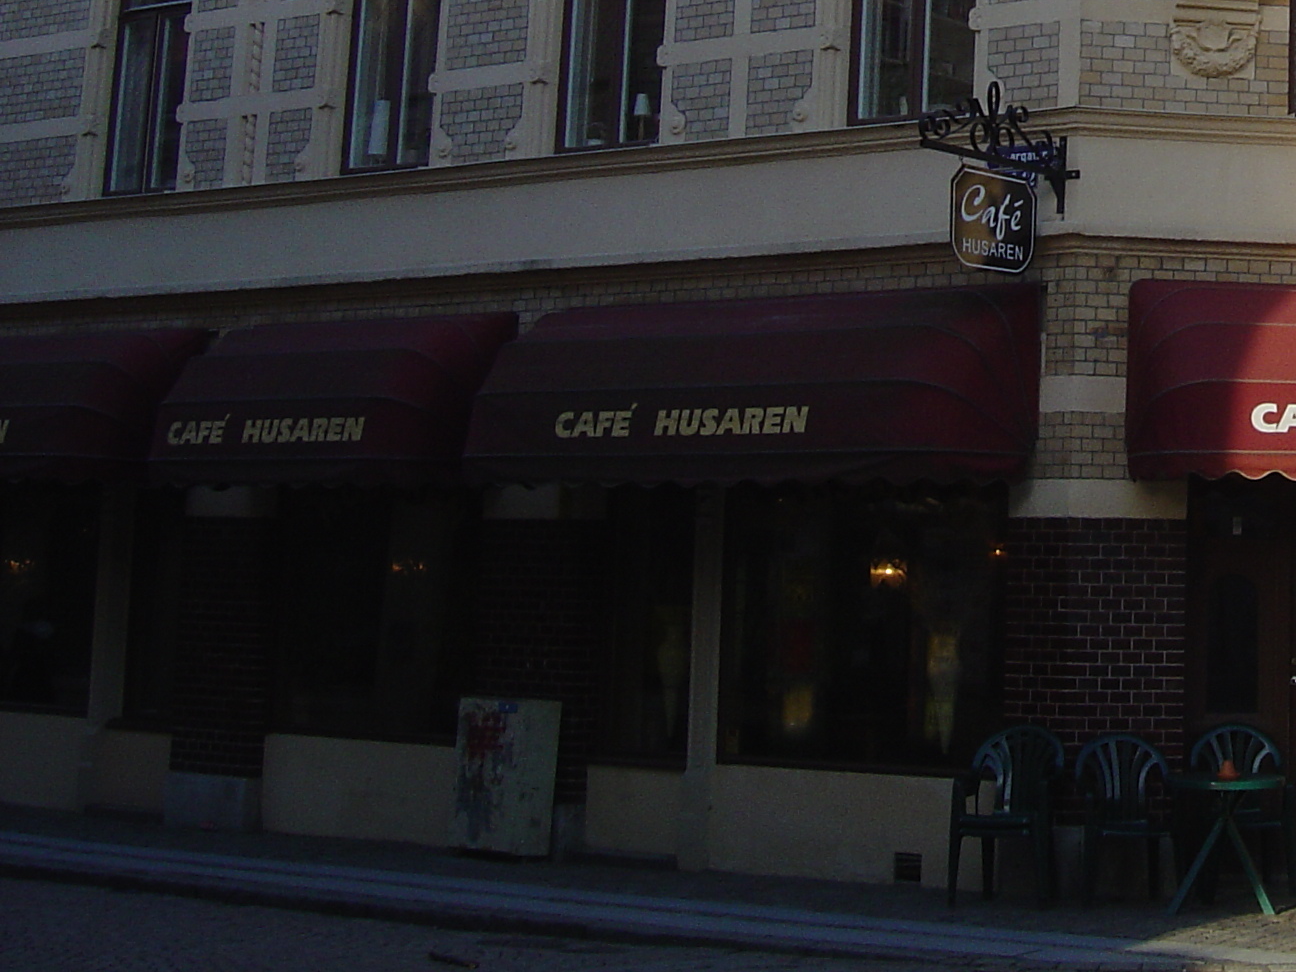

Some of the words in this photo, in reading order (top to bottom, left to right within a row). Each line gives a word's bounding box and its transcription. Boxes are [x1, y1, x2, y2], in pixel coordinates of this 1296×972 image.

[962, 184, 1024, 240] Café
[962, 237, 1023, 261] HUSAREN
[167, 413, 230, 444] CAFÉ
[241, 417, 365, 443] HUSAREN
[555, 403, 638, 438] CAFÉ
[653, 406, 809, 436] HUSAREN
